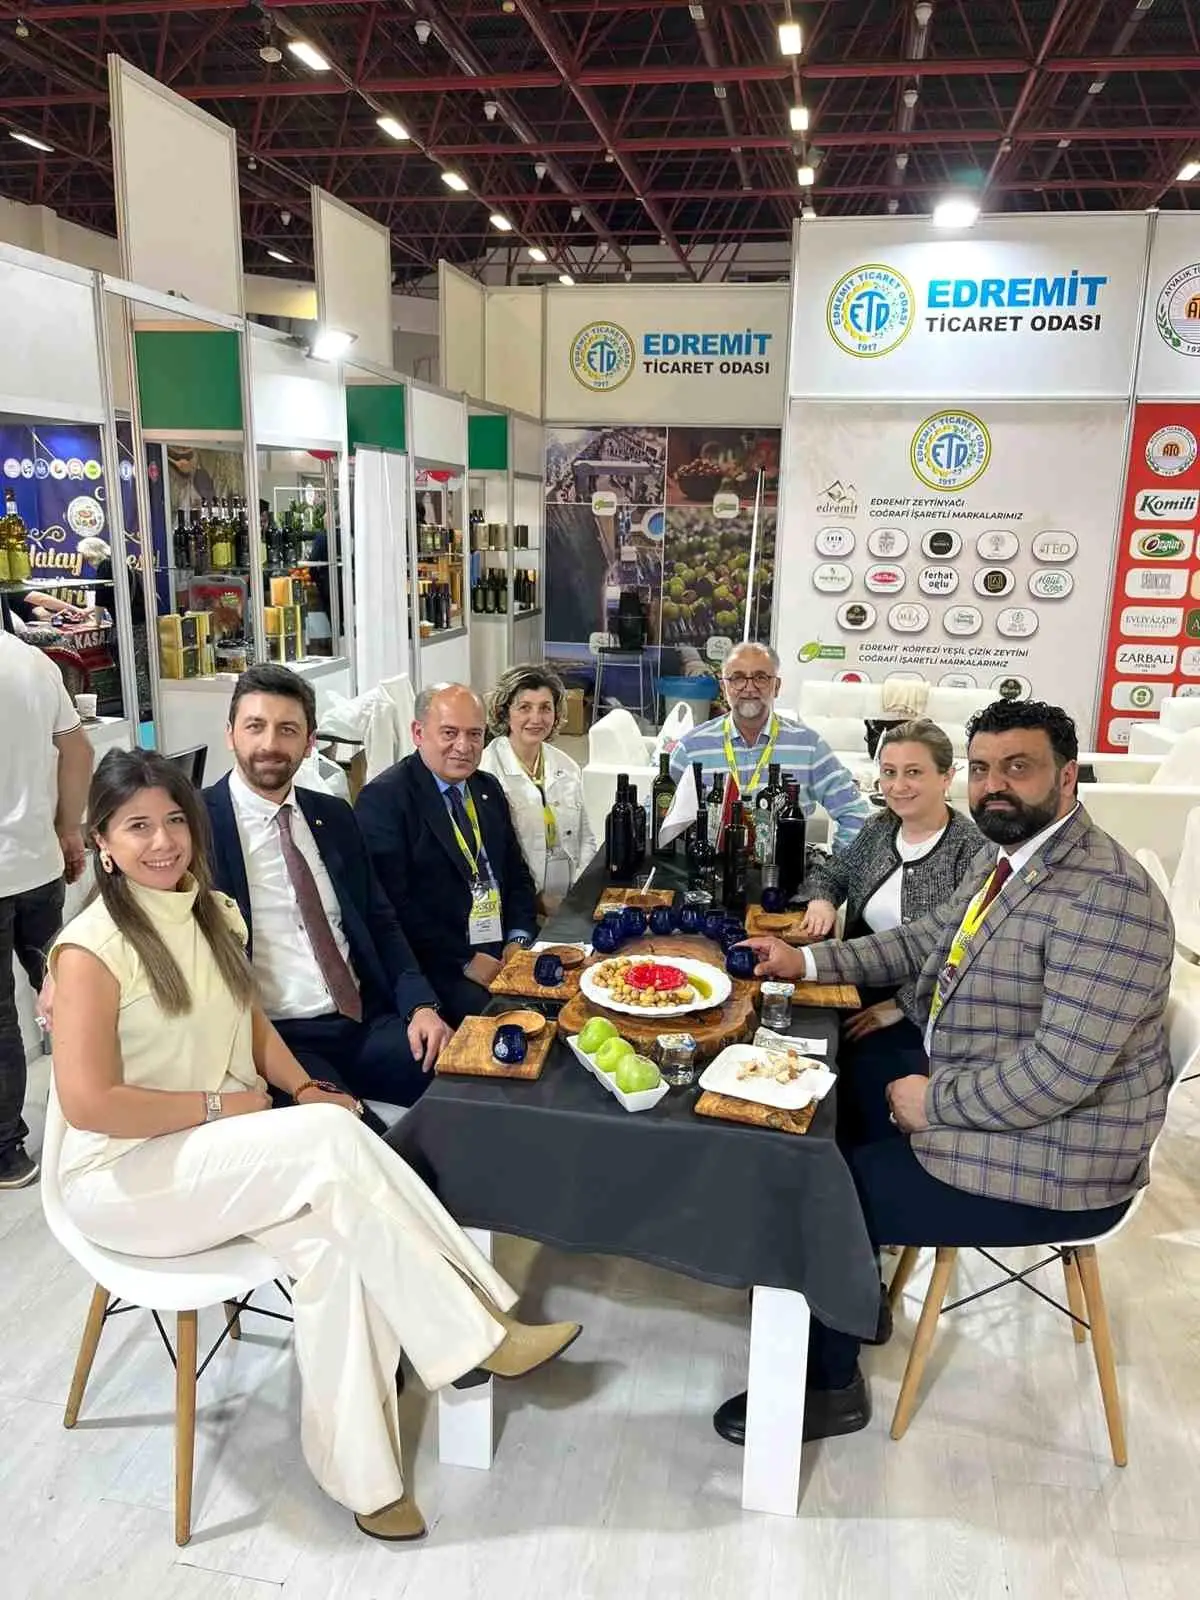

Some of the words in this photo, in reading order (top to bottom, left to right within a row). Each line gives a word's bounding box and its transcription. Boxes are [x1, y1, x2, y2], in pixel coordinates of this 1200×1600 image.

[926, 269, 1108, 308] EDREMİT
[925, 313, 1023, 333] TİCARET
[1030, 314, 1101, 331] ODASI
[643, 328, 772, 356] EDREMİT
[643, 359, 714, 375] TİCARET
[719, 361, 770, 375] ODASI
[951, 511, 1024, 520] MARKALARIMIZ
[1140, 495, 1196, 516] Komili
[924, 571, 953, 580] ferhat
